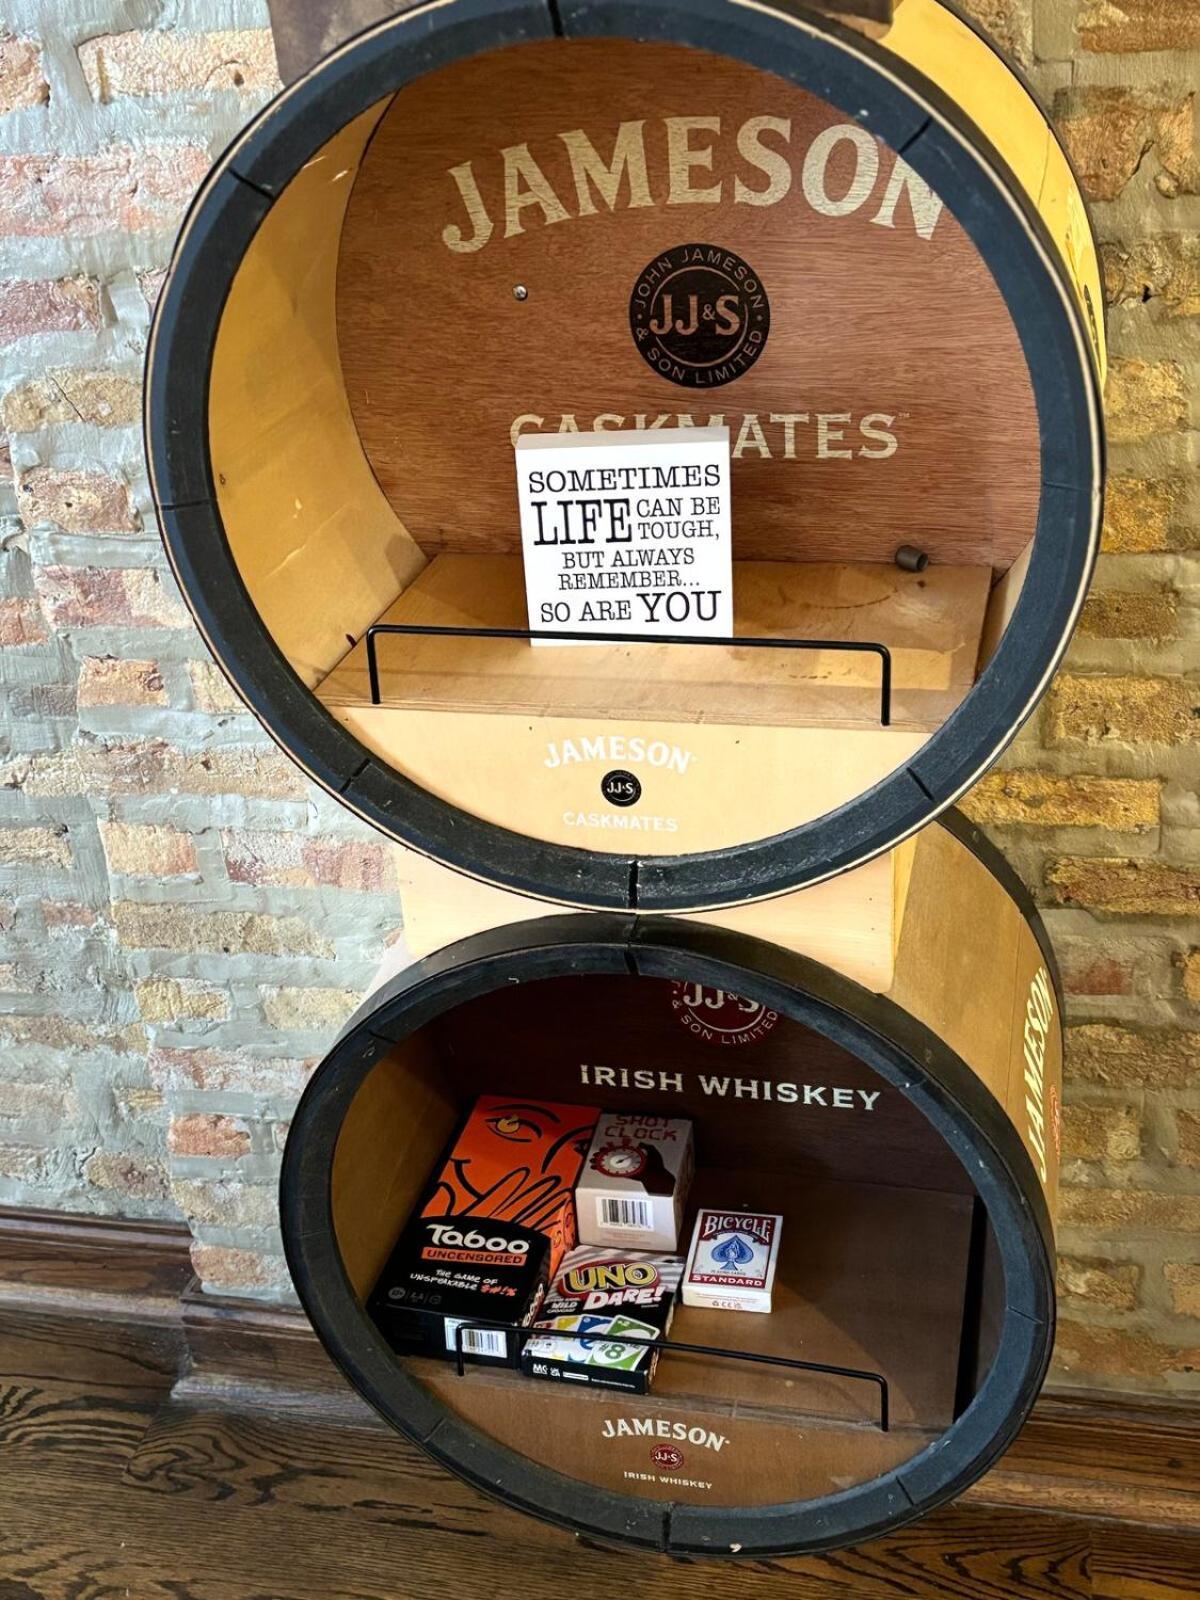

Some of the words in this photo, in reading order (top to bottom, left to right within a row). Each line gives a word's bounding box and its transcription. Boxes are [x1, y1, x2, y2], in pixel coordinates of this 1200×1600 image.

[441, 115, 945, 254] JAMESON
[635, 257, 673, 308] JOHN
[682, 248, 764, 309] JAMESON
[649, 294, 741, 336] JJ&S
[647, 347, 686, 380] SON
[695, 330, 762, 384] LIMITED
[529, 464, 721, 493] SOMETIMES
[531, 498, 633, 545] LIFE
[636, 498, 684, 518] CAN
[691, 497, 721, 515] BE
[638, 520, 720, 540] TOUGH,
[562, 551, 605, 569] BUT
[610, 548, 695, 568] ALWAYS
[558, 570, 700, 590] REMEMBER...
[541, 602, 571, 623] SO
[579, 600, 632, 622] ARE
[636, 591, 722, 623] YOU
[544, 735, 692, 775] JAMESON
[562, 810, 679, 832] CASKMATES
[681, 1014, 713, 1040] SON
[721, 1010, 779, 1044] LIMITED
[580, 1064, 685, 1092] IRISH
[698, 1074, 881, 1111] WHISKEY
[1023, 966, 1053, 1184] JAMESON
[605, 1126, 677, 1142] CLOCK
[426, 1224, 530, 1254] Taboo
[702, 1215, 772, 1243] BICYCLE
[427, 1249, 523, 1264] UNCENSORED
[564, 1261, 658, 1293] UNO
[692, 1274, 763, 1286] STANDARD
[583, 1286, 663, 1310] DARE!
[602, 1418, 726, 1453] JAMESON
[624, 1471, 656, 1482] IRISH
[659, 1476, 713, 1490] WHISKEY
